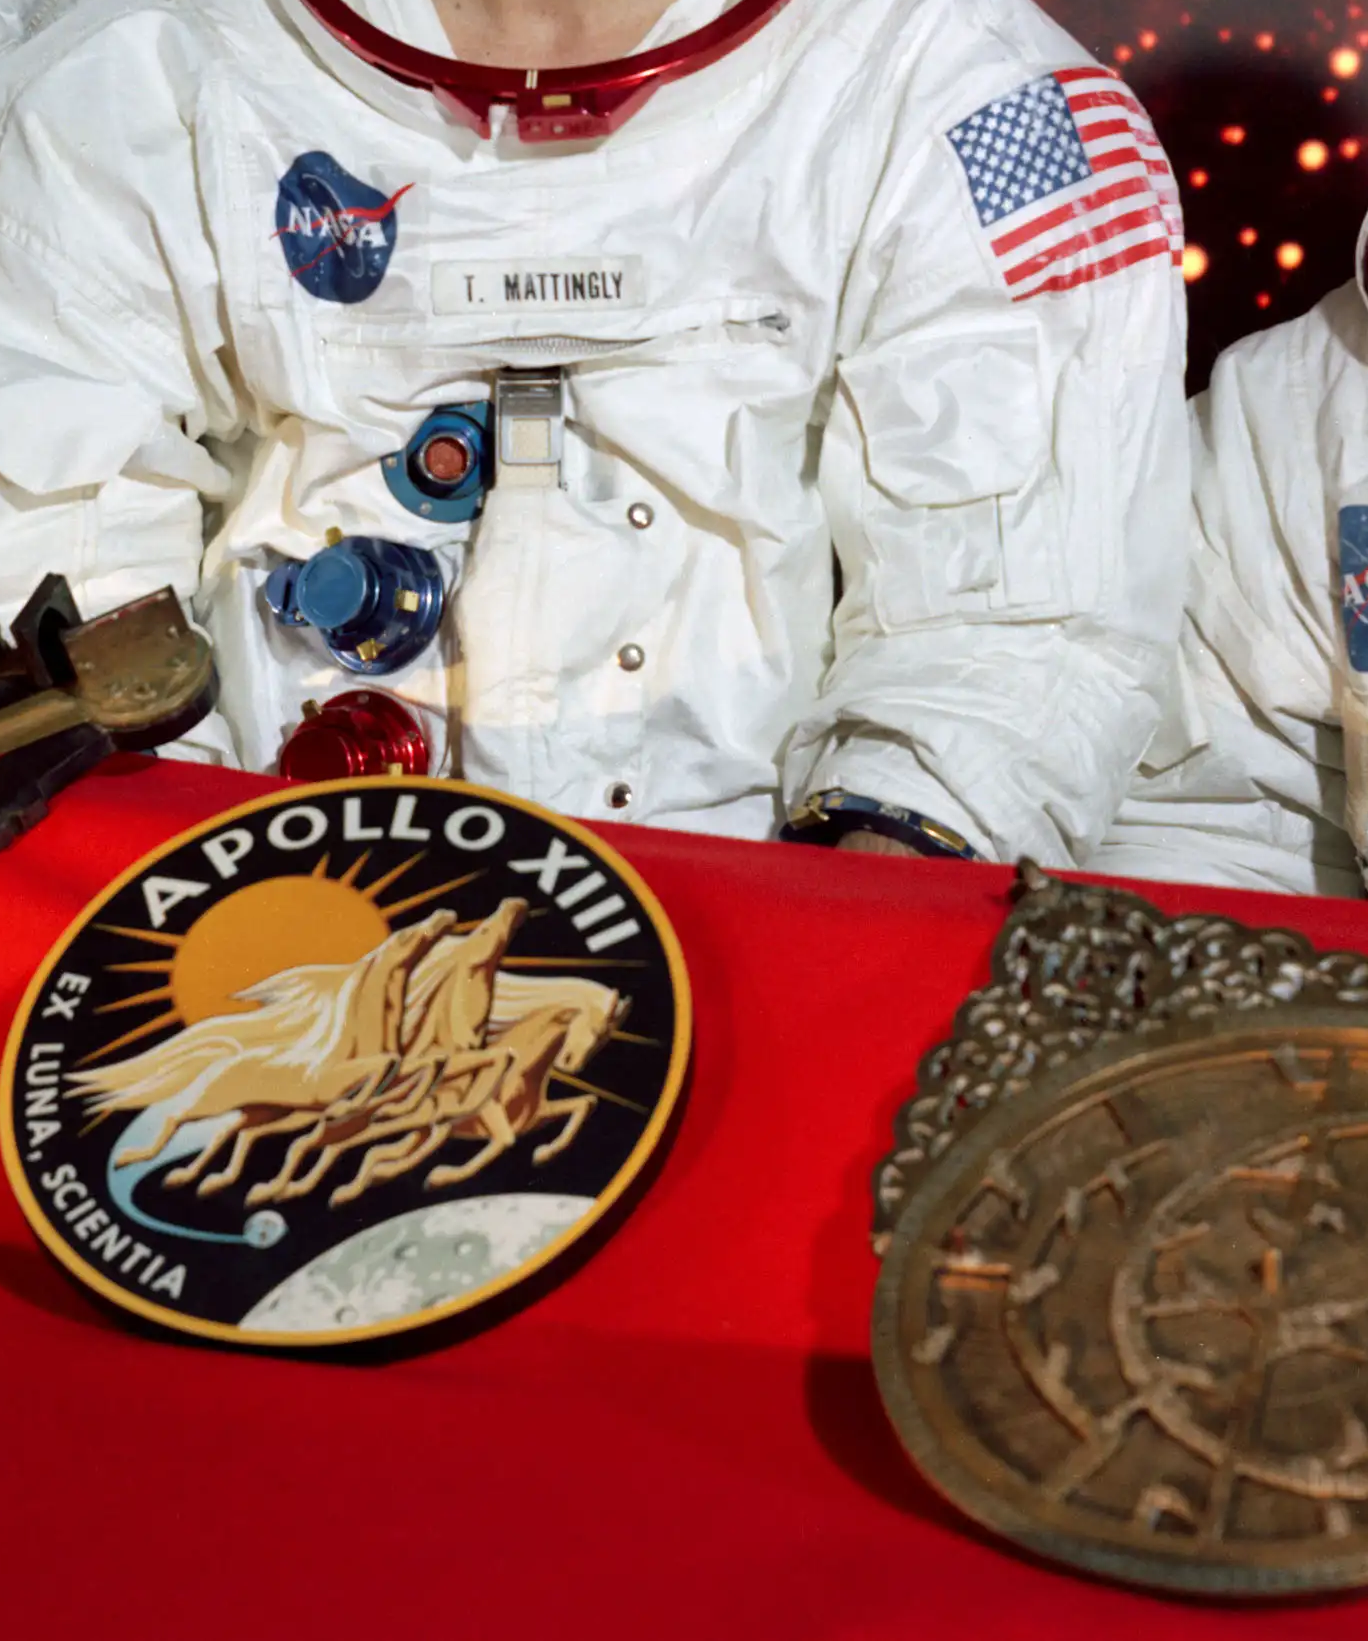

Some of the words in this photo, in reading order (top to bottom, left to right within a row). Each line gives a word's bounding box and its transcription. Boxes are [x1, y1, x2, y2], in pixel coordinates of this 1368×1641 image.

[287, 205, 389, 249] NASA
[464, 274, 484, 303] T.
[504, 272, 623, 302] MATTINGLY
[142, 795, 506, 929] APOLLO
[507, 838, 642, 954] XIII
[42, 971, 92, 1020] EX
[24, 1042, 65, 1162] LUNA,
[40, 1163, 187, 1300] SCIENTIA
